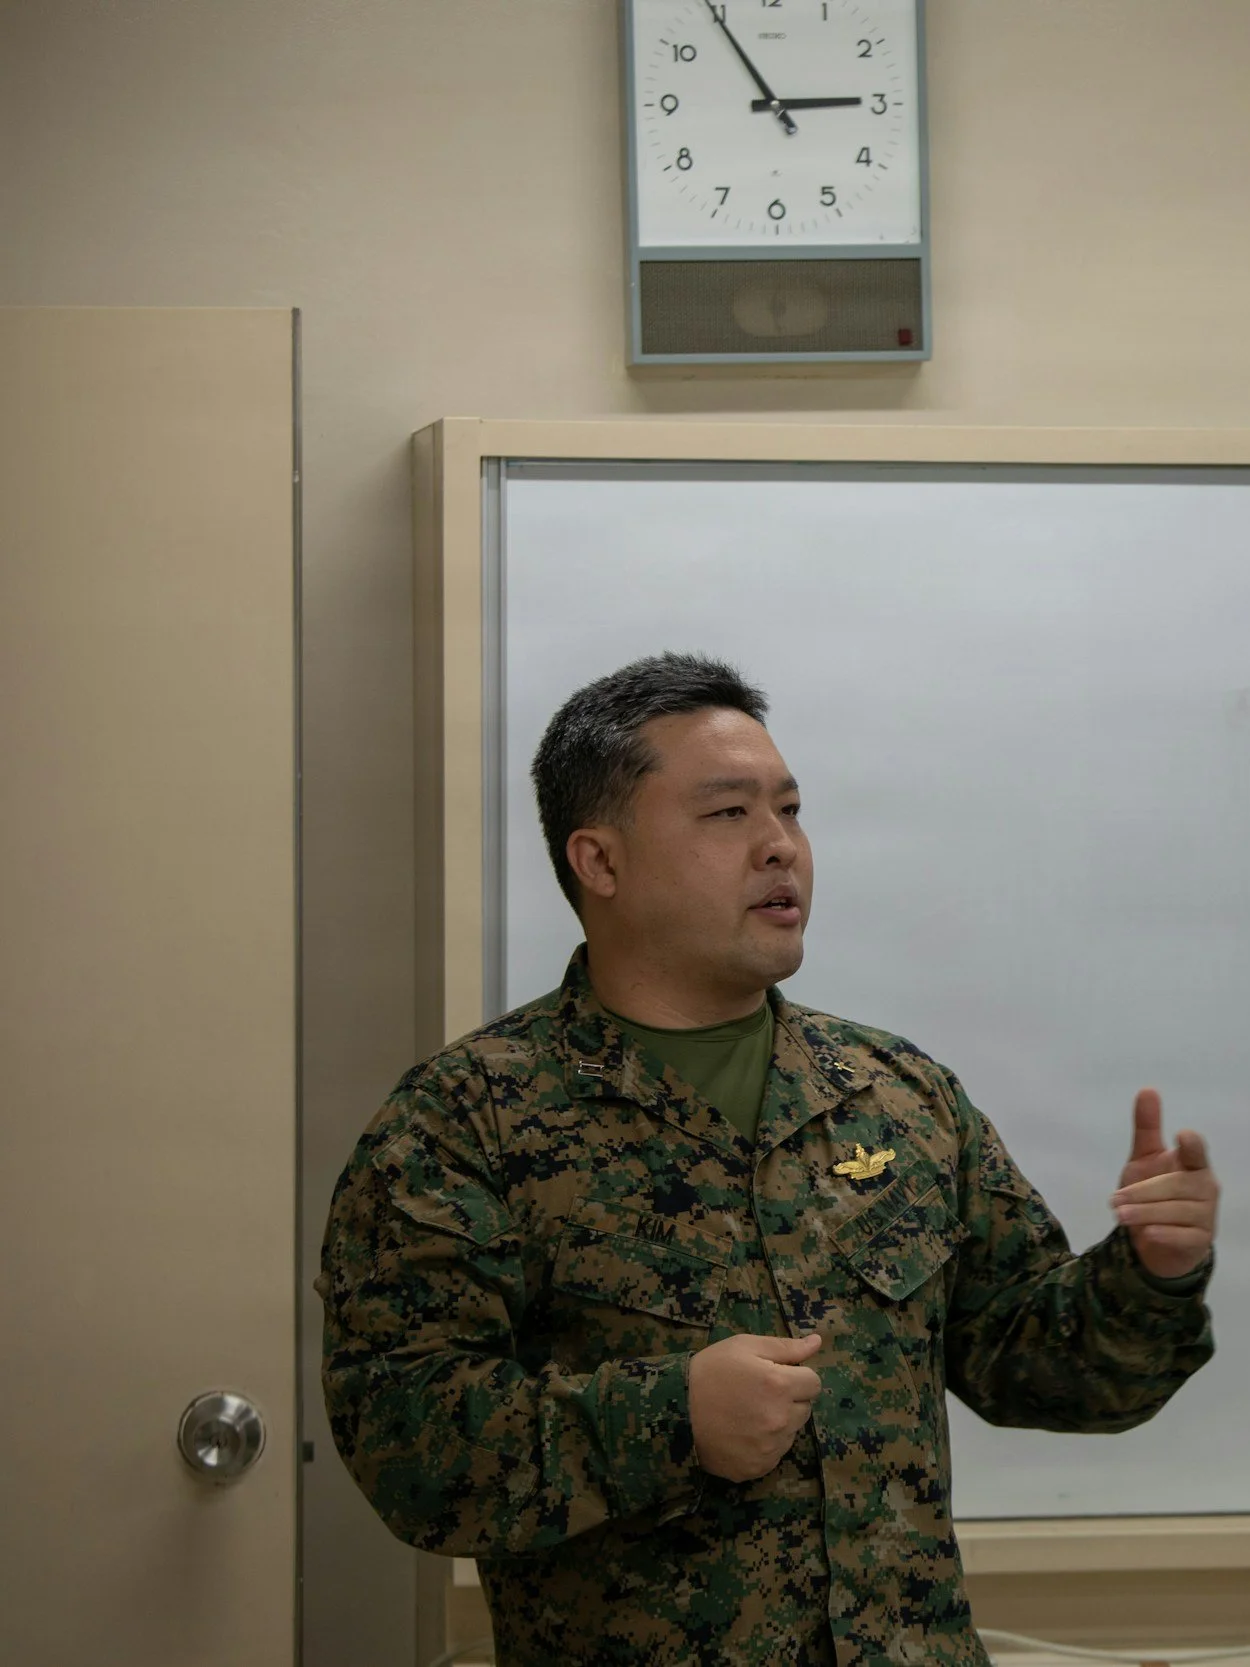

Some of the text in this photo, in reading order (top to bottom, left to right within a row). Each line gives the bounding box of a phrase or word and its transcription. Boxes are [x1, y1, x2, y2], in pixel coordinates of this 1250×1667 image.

[673, 44, 697, 62] 10
[856, 39, 872, 58] 2
[660, 94, 679, 116] 9
[871, 94, 887, 115] 3
[676, 148, 693, 171] 8
[856, 147, 872, 167] 4
[715, 187, 730, 206] 7
[820, 186, 836, 207] 5
[767, 199, 786, 220] 6
[635, 1216, 677, 1245] KIM
